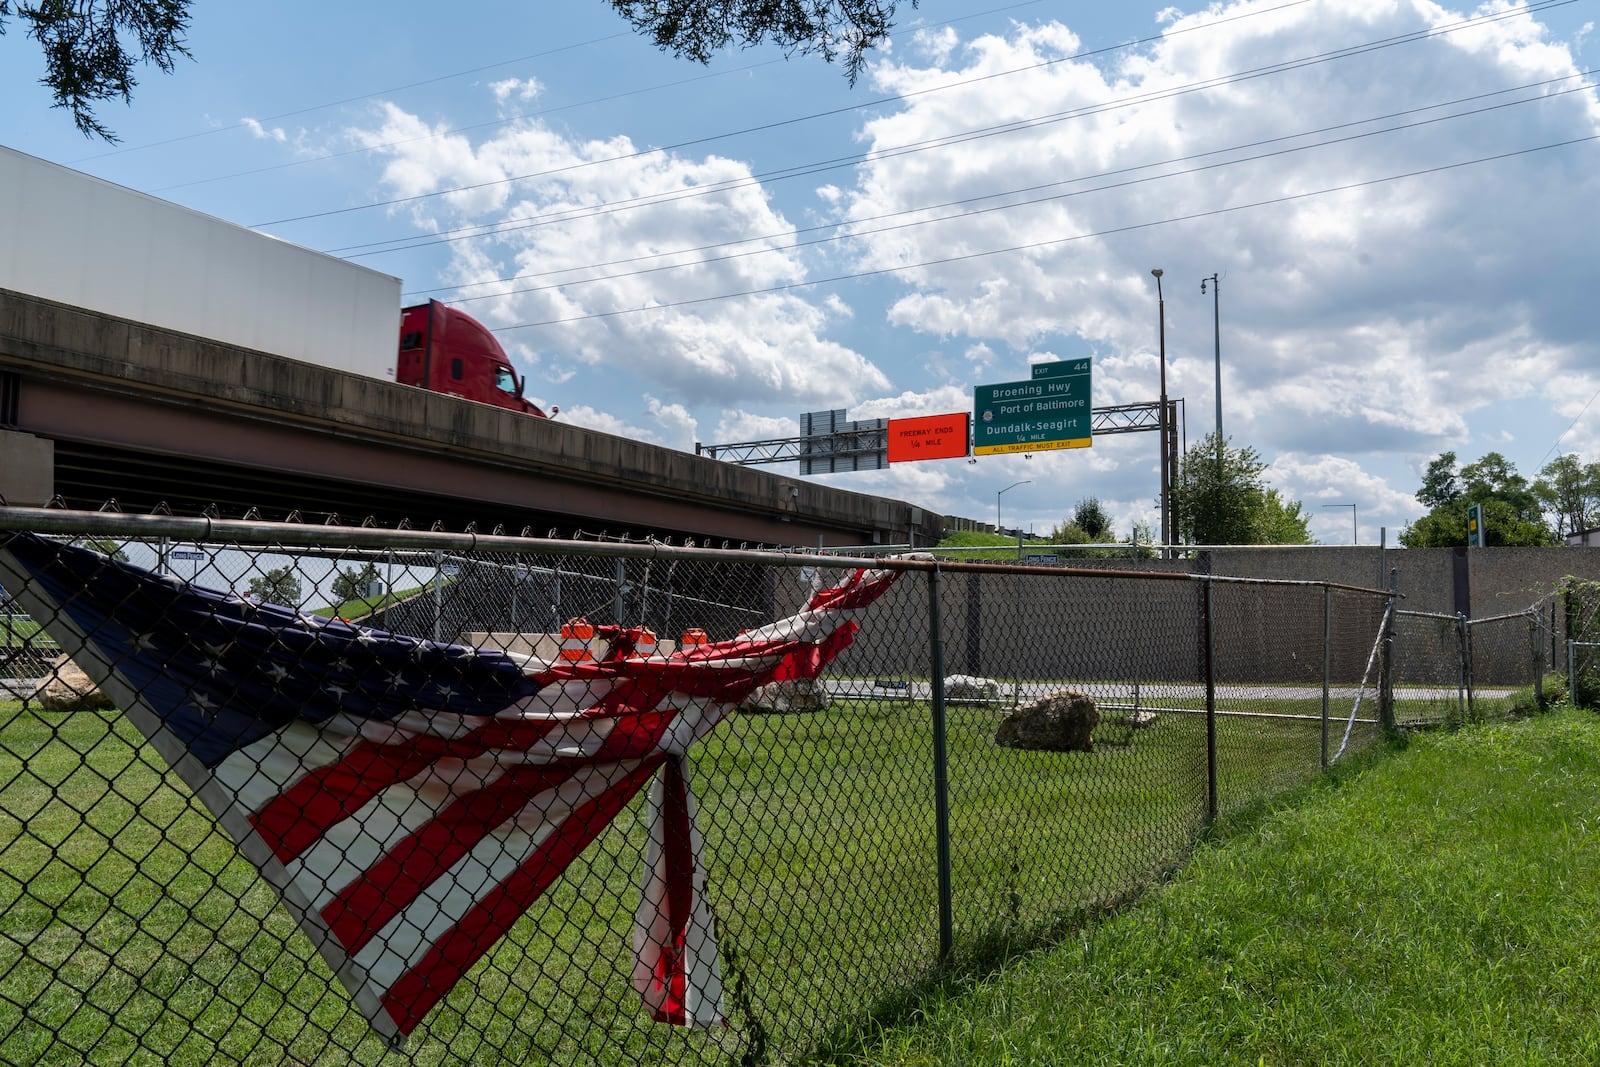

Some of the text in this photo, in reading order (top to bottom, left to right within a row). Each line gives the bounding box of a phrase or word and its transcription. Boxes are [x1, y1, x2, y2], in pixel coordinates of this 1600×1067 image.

[1073, 362, 1088, 371] 44
[992, 383, 1071, 398] Broening Hwy
[1000, 399, 1085, 414] Port of Baltimore
[899, 426, 953, 437] FREEWAY ENDS
[986, 419, 1077, 435] Dundalk-Seagirt
[925, 438, 942, 446] MILE
